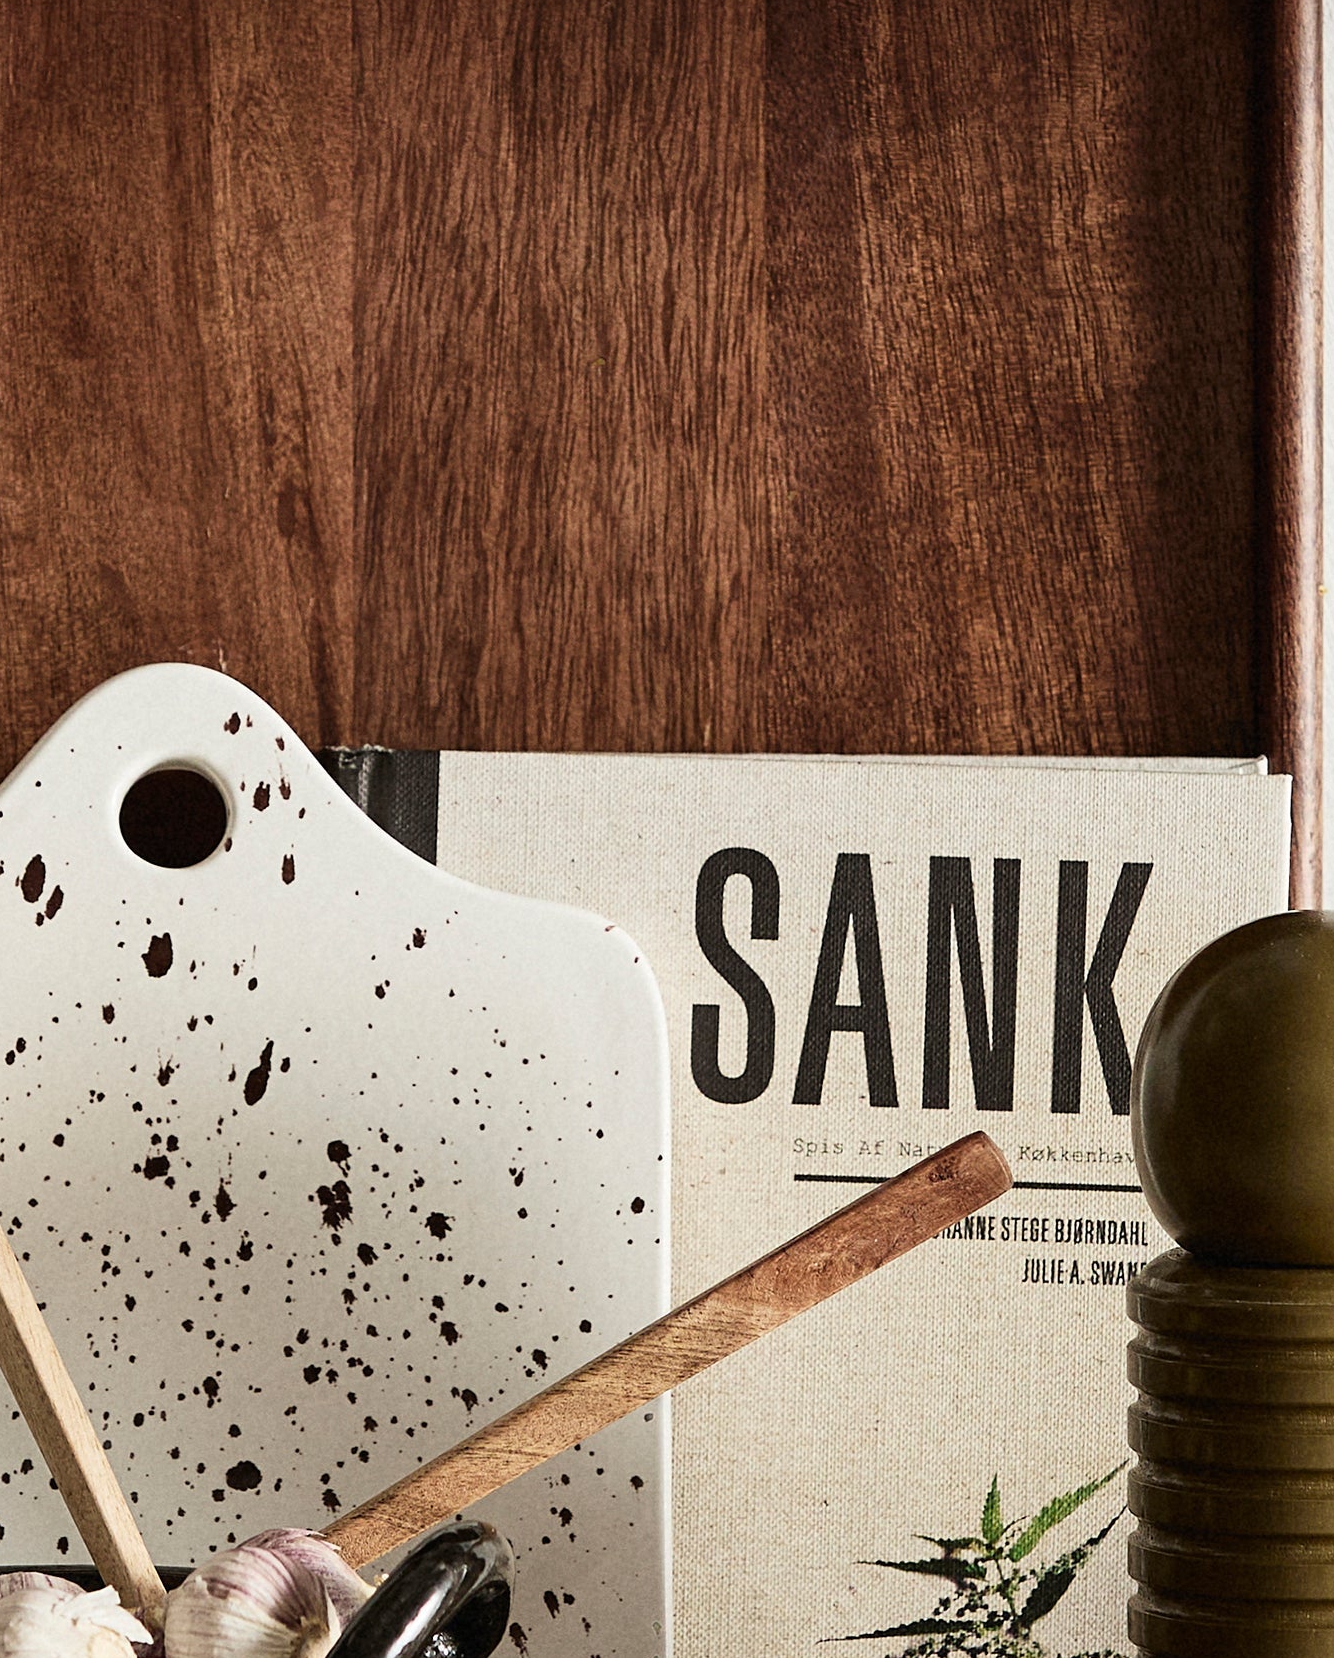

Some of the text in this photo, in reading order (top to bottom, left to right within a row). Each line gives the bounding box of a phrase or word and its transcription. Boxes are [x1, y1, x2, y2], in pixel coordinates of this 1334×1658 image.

[792, 1137, 844, 1157] Spis
[858, 1139, 885, 1156] Af
[1001, 1216, 1050, 1243] STEGE
[1054, 1218, 1149, 1247] BJØRNDAHL
[1021, 1258, 1147, 1287] JULIE A. SWAN
